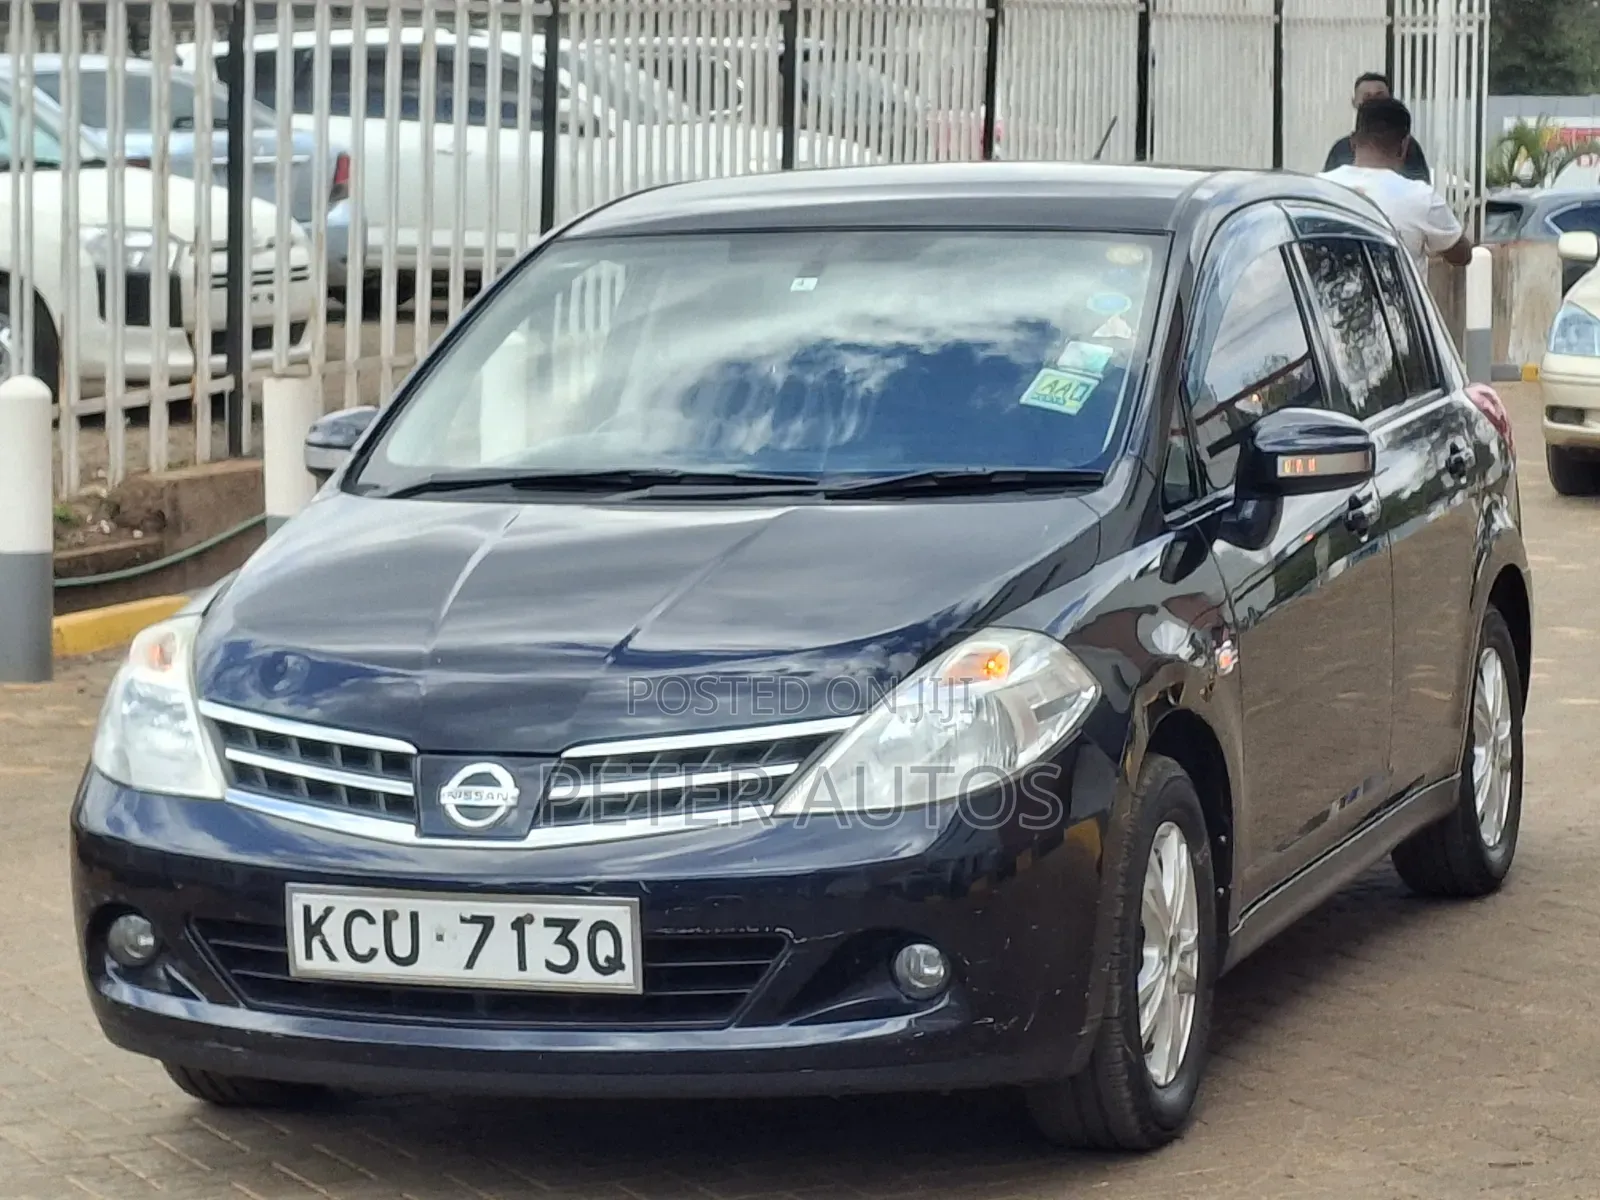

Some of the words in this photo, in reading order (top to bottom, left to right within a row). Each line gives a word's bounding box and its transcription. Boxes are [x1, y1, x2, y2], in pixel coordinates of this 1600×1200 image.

[446, 790, 509, 801] NISSAN
[302, 904, 419, 967] KCU
[459, 912, 626, 976] 713Q
